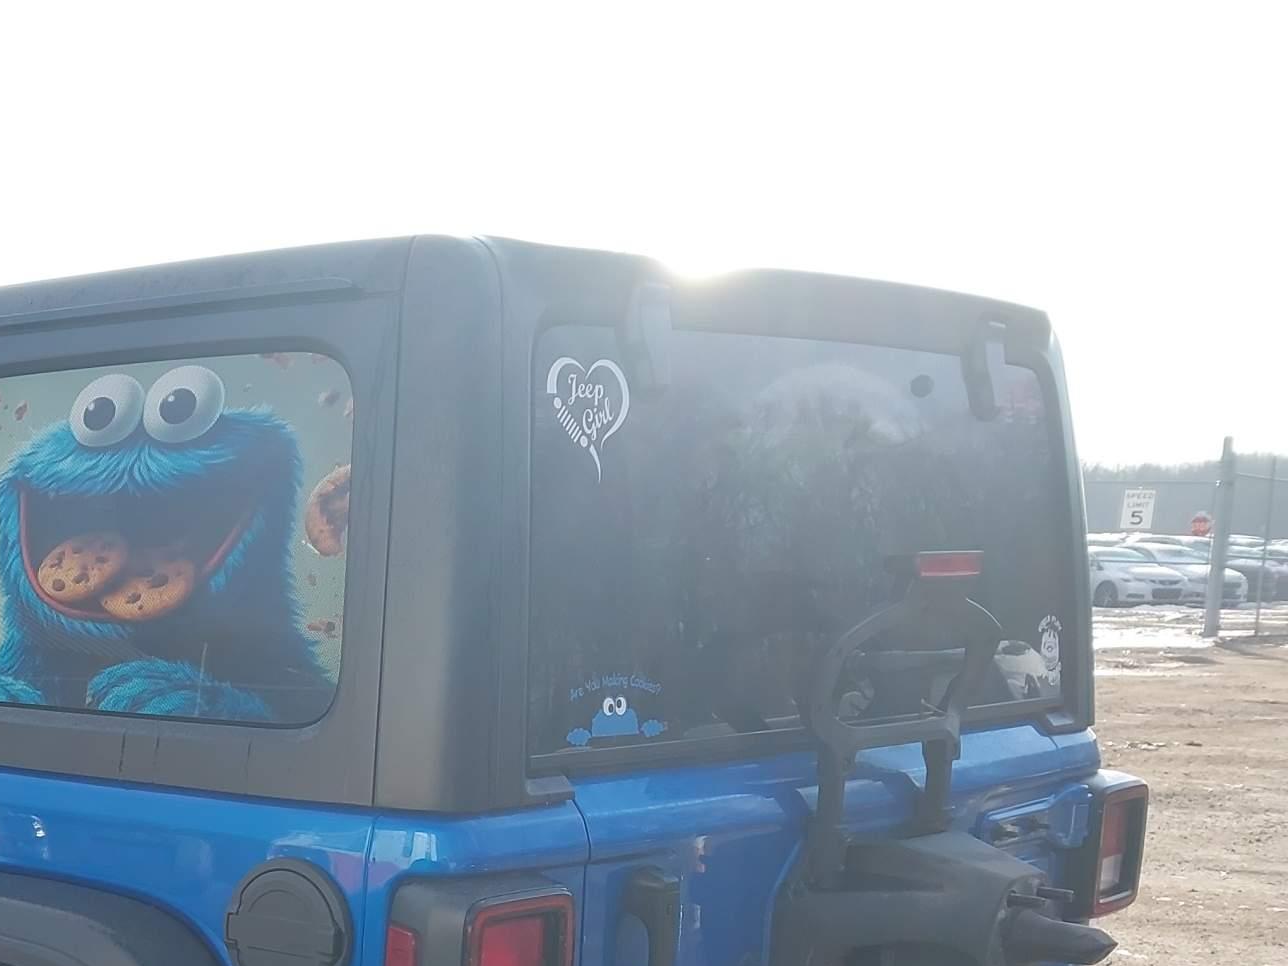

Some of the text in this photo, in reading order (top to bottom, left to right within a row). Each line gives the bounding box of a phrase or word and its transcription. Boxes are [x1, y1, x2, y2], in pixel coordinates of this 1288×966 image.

[567, 373, 604, 406] Jeep
[582, 397, 615, 441] Girl
[1130, 510, 1143, 525] 5
